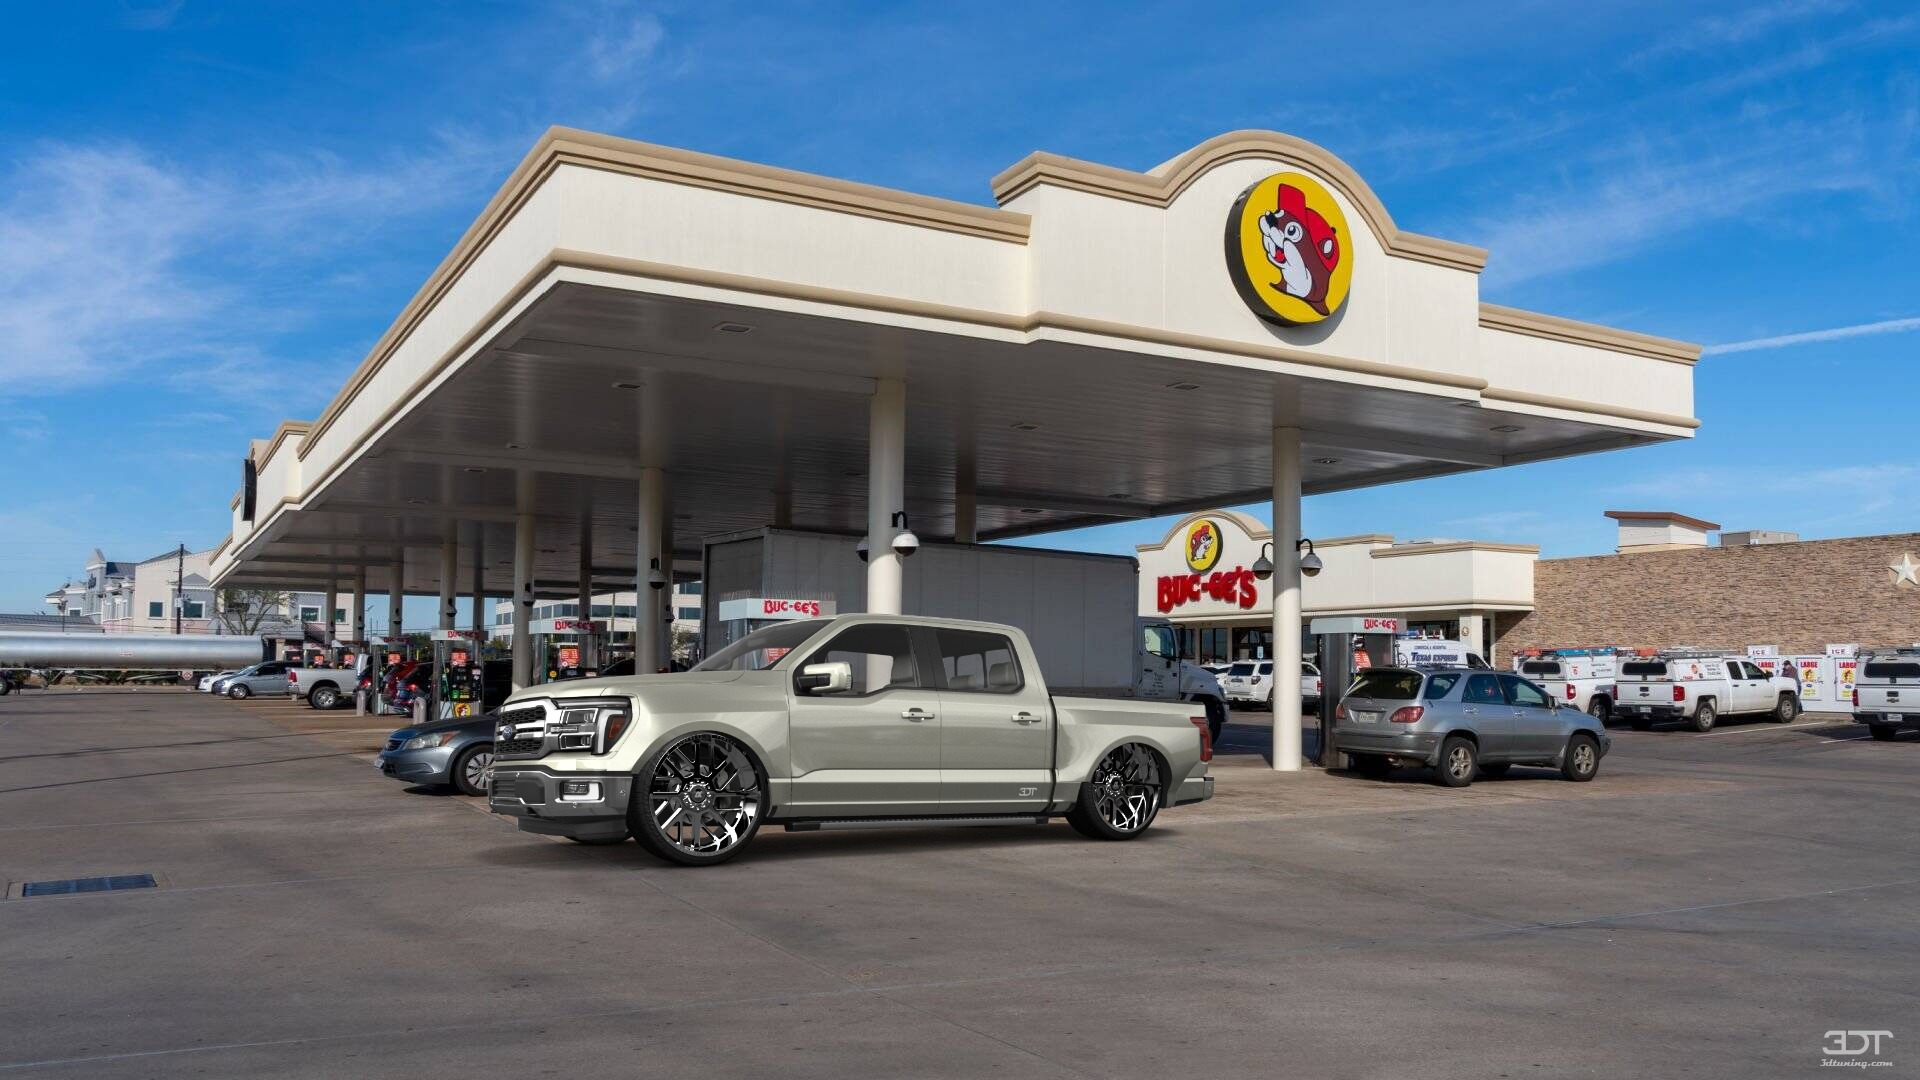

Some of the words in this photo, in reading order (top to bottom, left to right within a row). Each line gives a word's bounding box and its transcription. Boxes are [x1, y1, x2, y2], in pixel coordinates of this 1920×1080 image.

[1157, 565, 1258, 614] BUC-EE'S
[764, 599, 820, 617] BUC-EE'S
[1839, 661, 1857, 669] LARGE
[1018, 787, 1038, 797] 3DT
